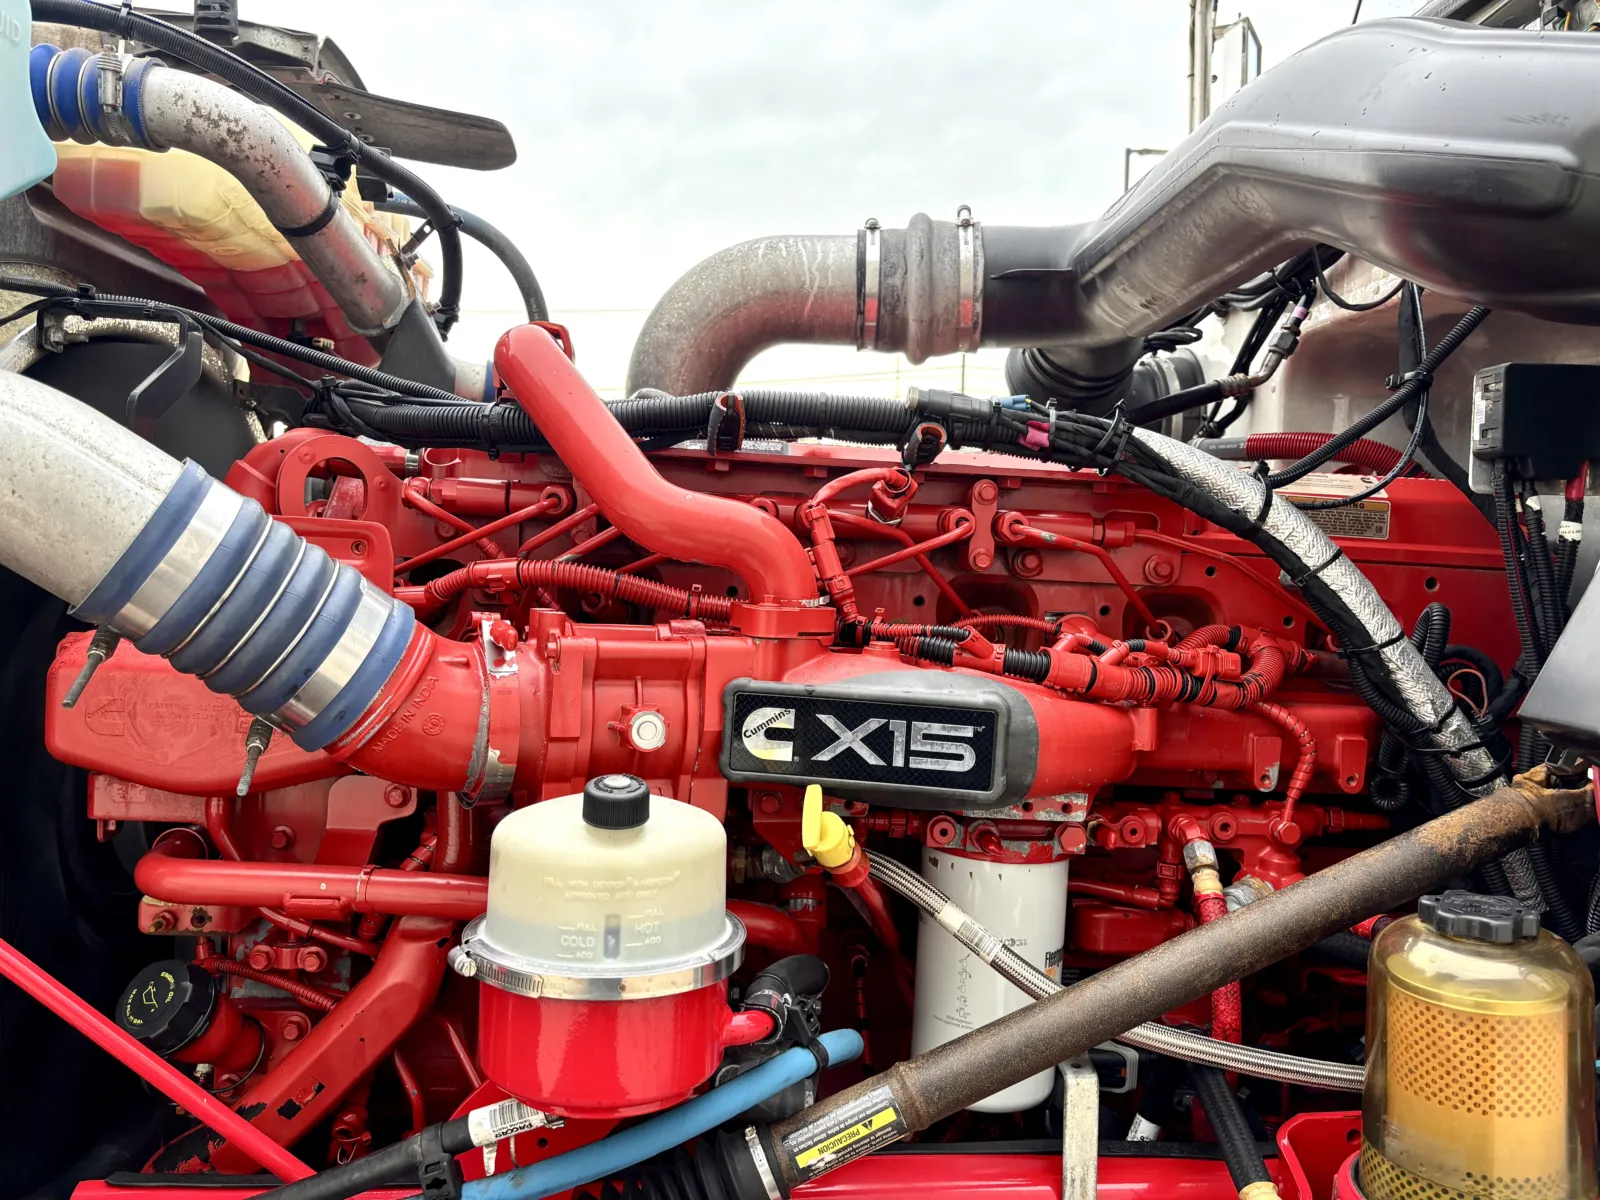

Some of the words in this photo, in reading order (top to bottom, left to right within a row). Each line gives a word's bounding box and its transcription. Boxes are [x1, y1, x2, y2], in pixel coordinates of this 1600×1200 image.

[372, 722, 406, 752] MADE
[401, 710, 416, 724] IN
[412, 676, 439, 709] INDIA
[743, 709, 791, 739] Cummins
[811, 714, 976, 772] X15
[634, 921, 660, 933] HOT
[560, 935, 595, 947] COLD
[644, 936, 661, 944] ADD
[165, 991, 174, 1003] OIL
[817, 1128, 860, 1155] PRECAUCION
